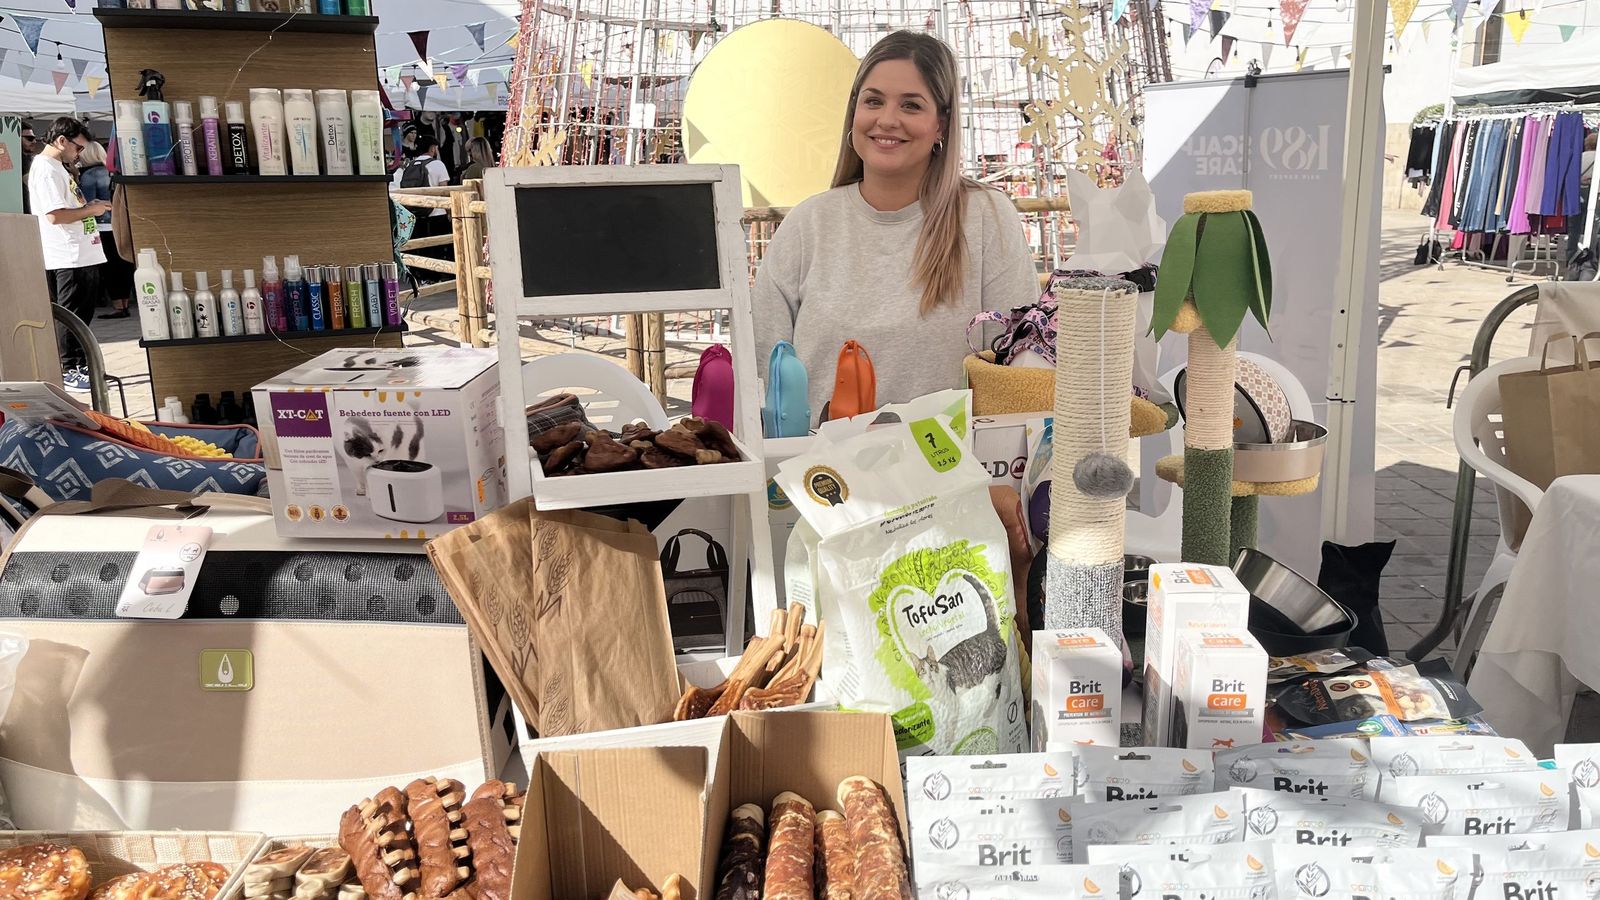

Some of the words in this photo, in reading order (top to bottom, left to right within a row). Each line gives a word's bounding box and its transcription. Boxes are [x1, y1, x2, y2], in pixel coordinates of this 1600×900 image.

[208, 129, 218, 161] KERATIN
[260, 122, 269, 162] Vitalizante
[327, 124, 335, 146] Detox
[231, 132, 244, 164] DETOX
[313, 292, 321, 320] CLASSIC
[333, 291, 343, 318] TIERRA
[351, 289, 361, 318] FRESH
[370, 293, 379, 314] BABY
[388, 290, 398, 316] VIOLET
[339, 409, 381, 417] Bebedero
[383, 409, 411, 417] fuente
[431, 409, 451, 417] LED
[924, 432, 937, 449] 7
[930, 447, 950, 458] LITROS
[817, 484, 837, 495] QUALITY
[902, 591, 964, 628] TofuSan
[1069, 680, 1102, 694] Brit
[1212, 679, 1245, 692] Brit
[1071, 697, 1099, 709] care
[1212, 697, 1242, 707] care
[1464, 816, 1516, 836] Brit
[1295, 830, 1352, 847] Brit
[978, 842, 1032, 867] Brit
[1502, 880, 1558, 900] Brit
